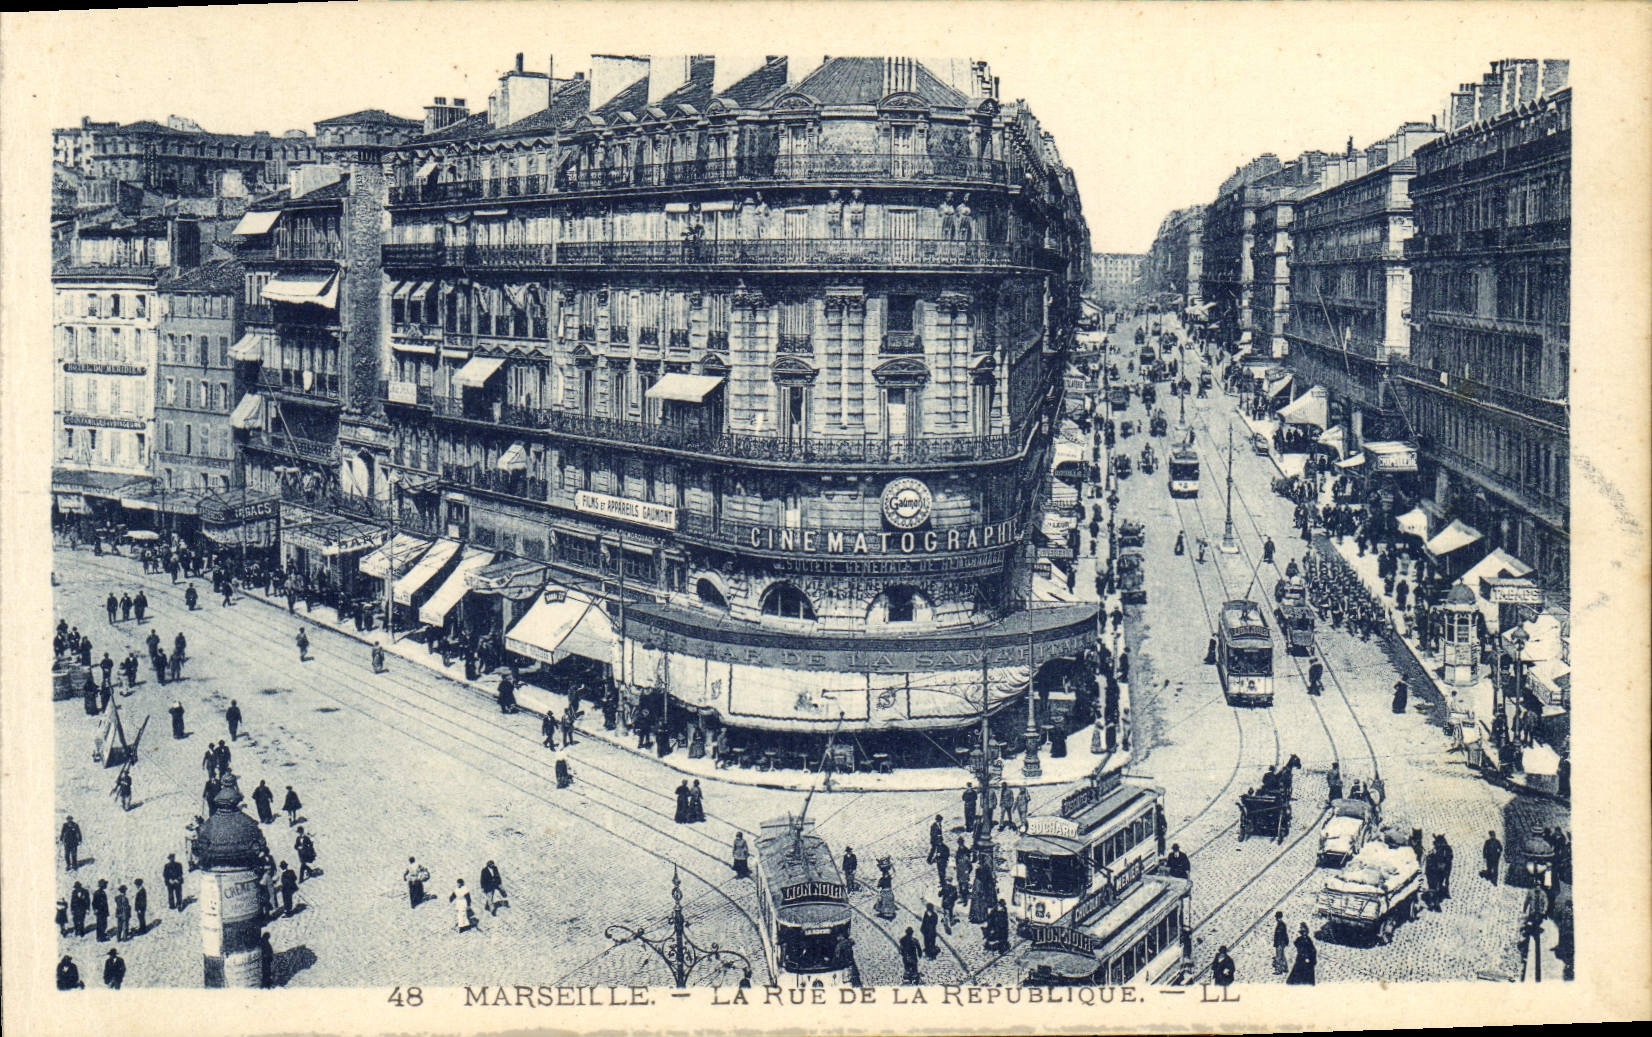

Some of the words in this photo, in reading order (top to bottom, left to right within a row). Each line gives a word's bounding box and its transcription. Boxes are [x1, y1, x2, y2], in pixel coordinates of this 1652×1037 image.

[582, 494, 599, 510] FILMS
[607, 499, 639, 518] APPAREILS
[642, 505, 673, 525] GAUMONT
[780, 650, 827, 667] DE
[847, 652, 893, 668] LA
[784, 883, 811, 901] LION
[814, 882, 842, 899] NOIR
[1035, 926, 1061, 945] LION
[1063, 929, 1092, 952] NOIR
